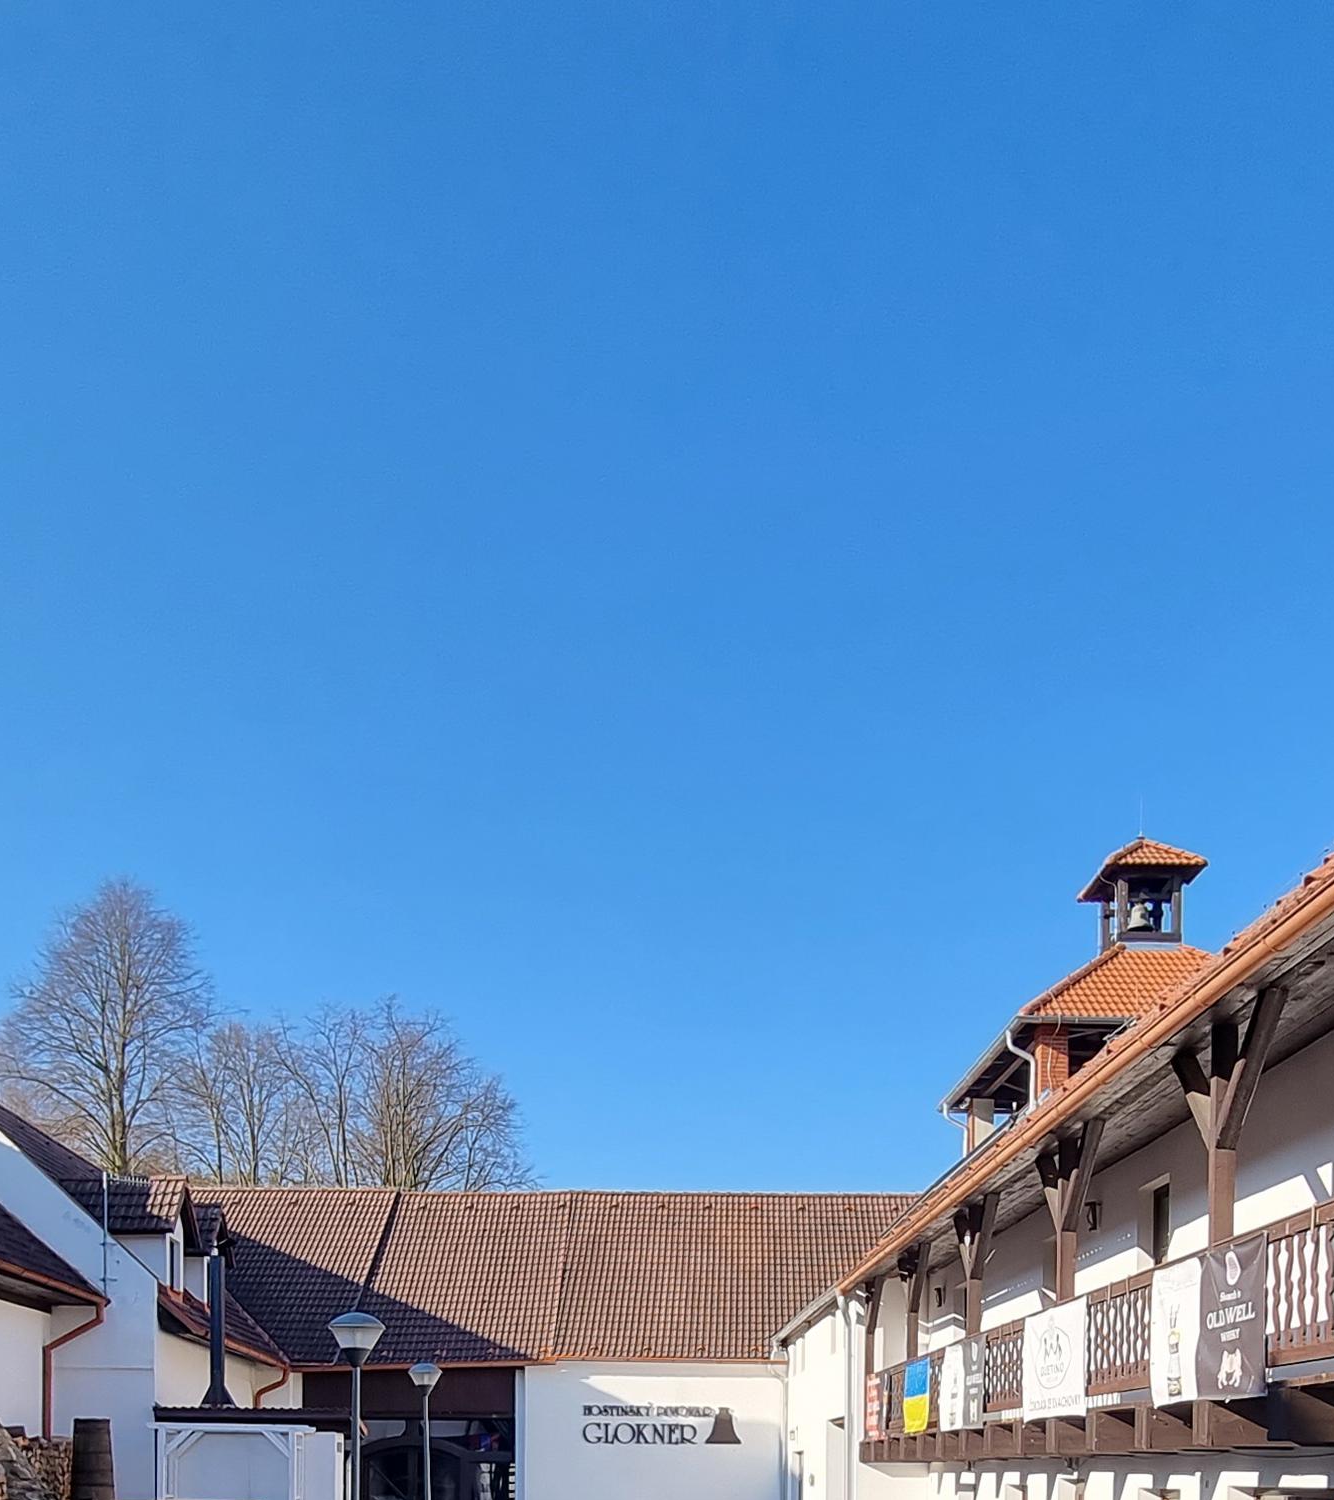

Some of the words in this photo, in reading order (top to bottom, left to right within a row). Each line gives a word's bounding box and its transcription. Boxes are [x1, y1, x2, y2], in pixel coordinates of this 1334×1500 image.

[1206, 1308, 1224, 1330] OLD
[1224, 1301, 1256, 1325] WELL
[582, 1422, 698, 1445] GLOKNER
